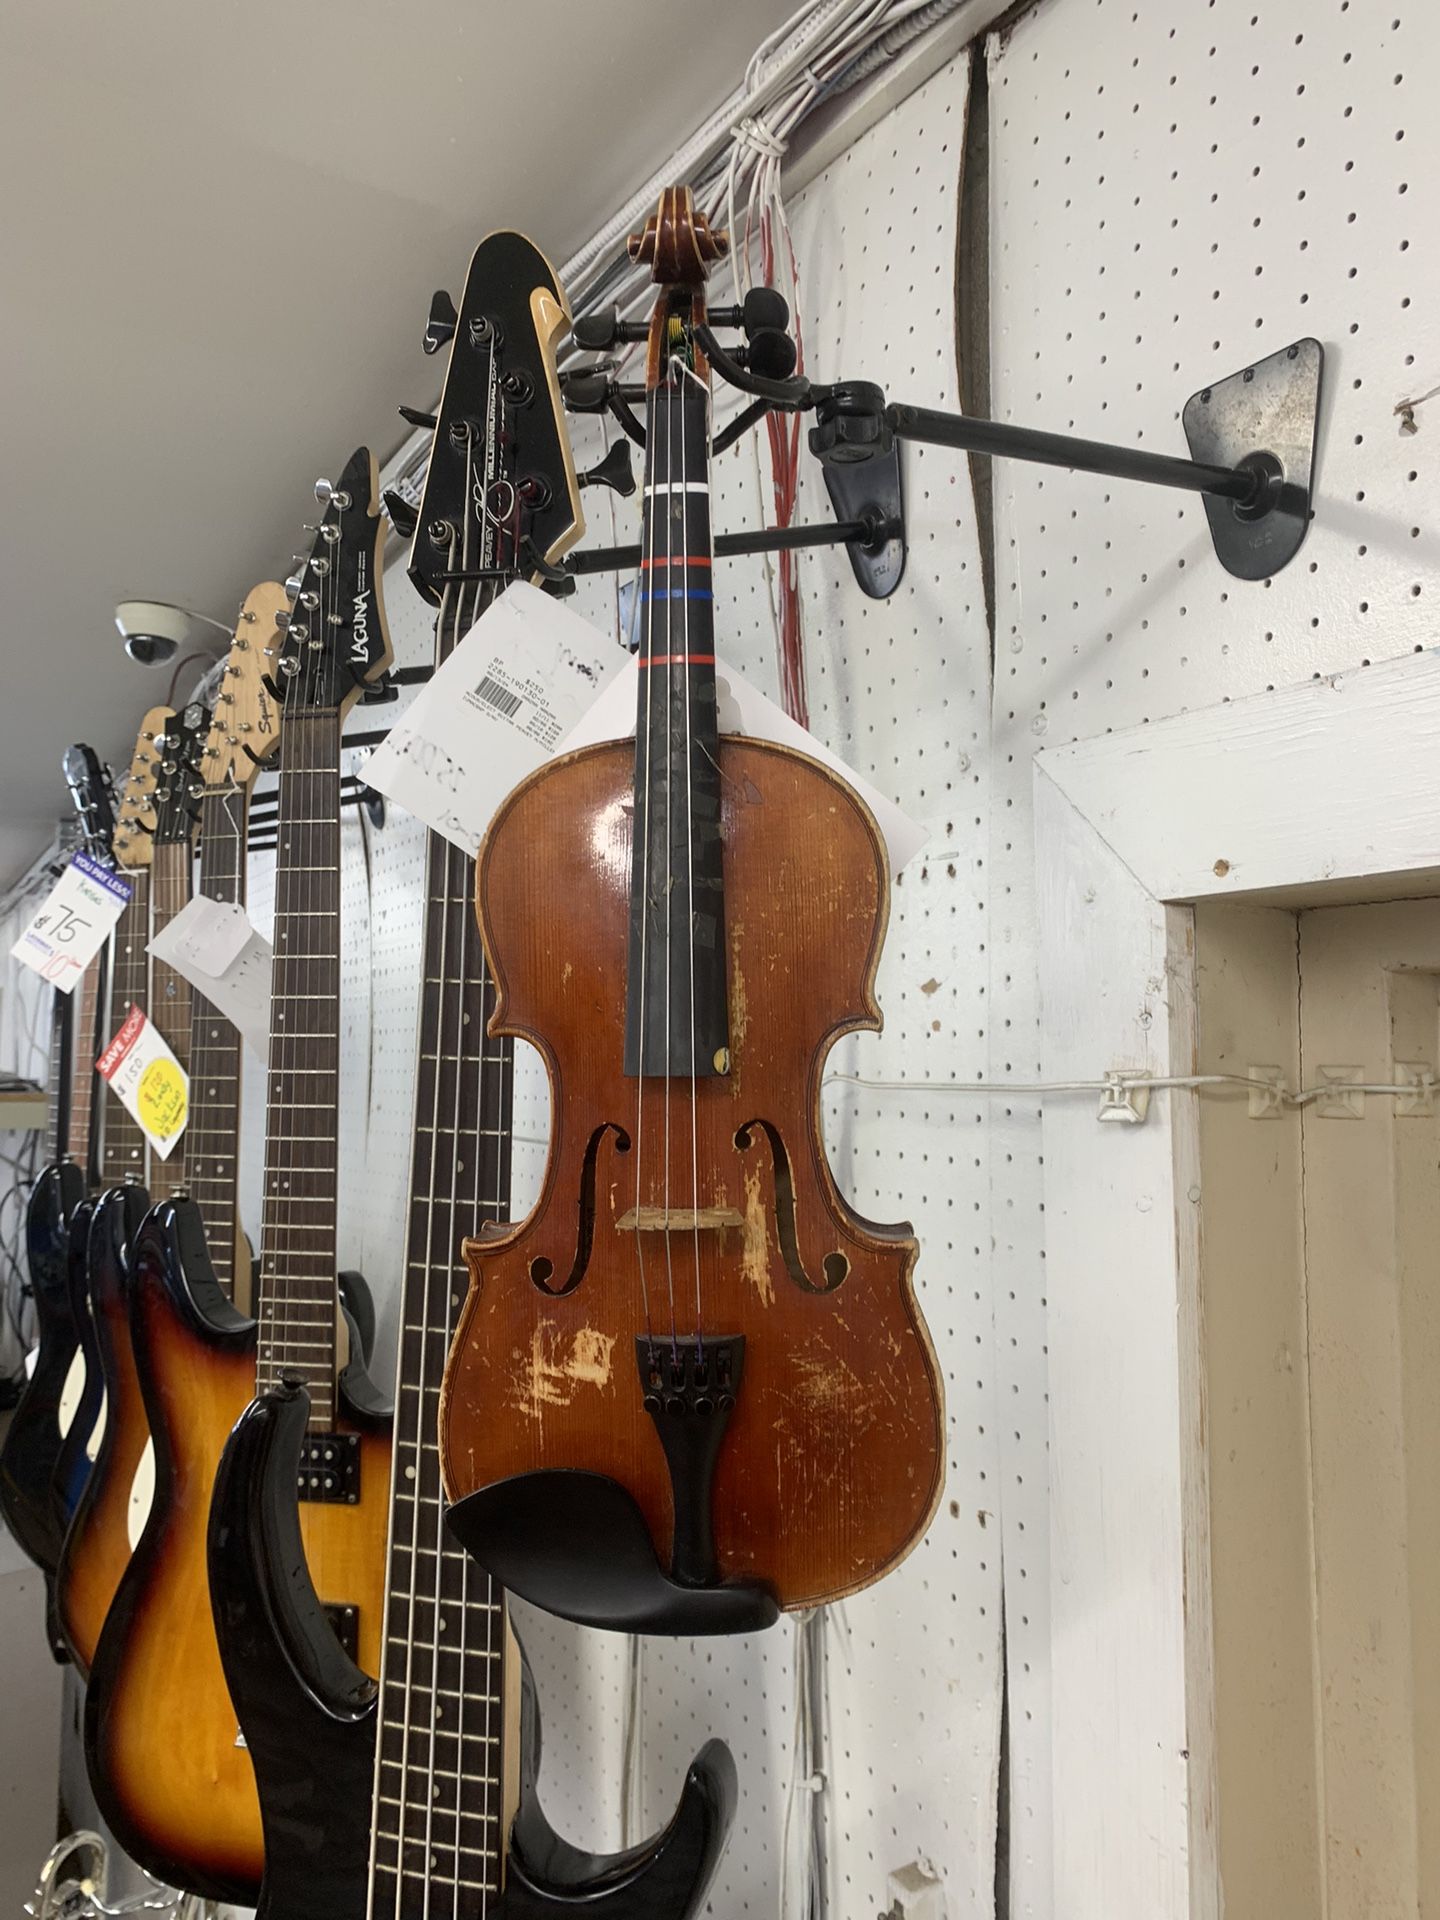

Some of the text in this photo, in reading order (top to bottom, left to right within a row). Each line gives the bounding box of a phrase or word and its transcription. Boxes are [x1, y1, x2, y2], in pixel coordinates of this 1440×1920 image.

[488, 401, 496, 480] MILLENNIUM
[484, 525, 494, 569] PEAVEY
[351, 589, 370, 664] LAGUNA
[488, 662, 550, 708] 2285-190130-01
[493, 657, 545, 694] BP $250
[258, 689, 273, 737] Squier
[75, 855, 132, 899] YOU PAY LESS!
[100, 1039, 125, 1074] SAVE
